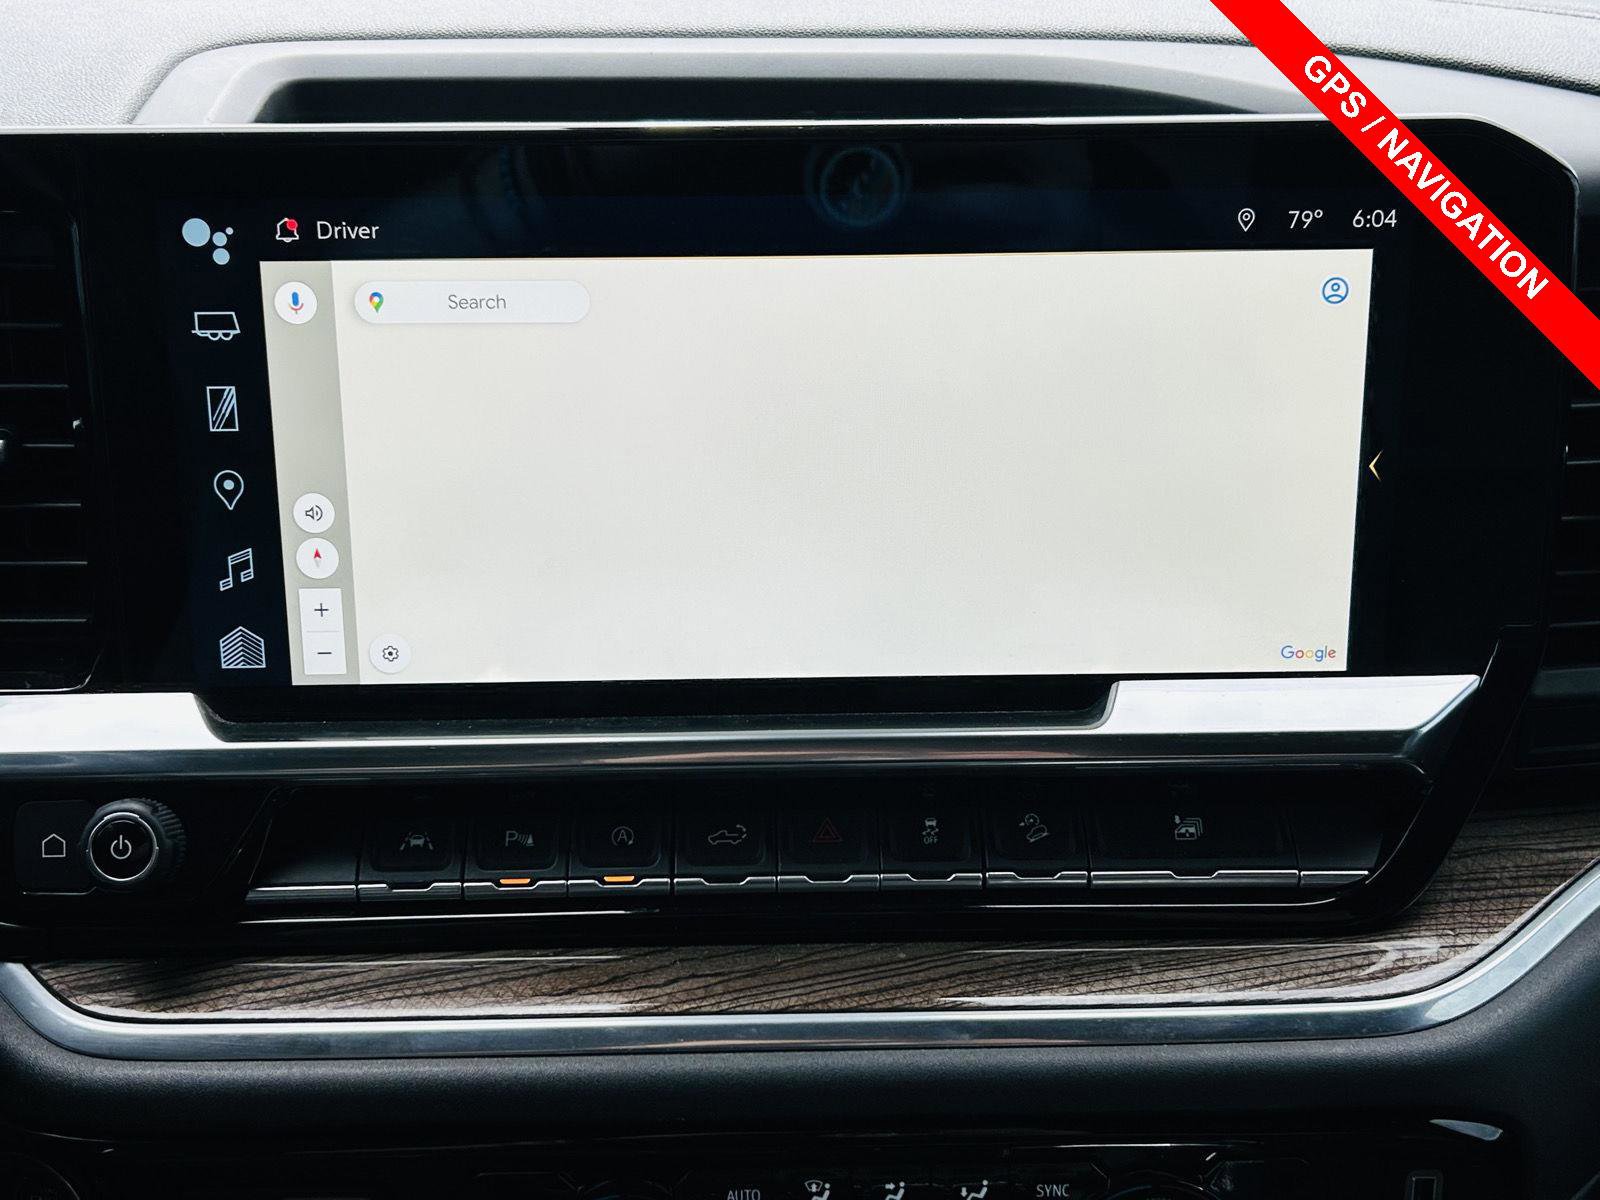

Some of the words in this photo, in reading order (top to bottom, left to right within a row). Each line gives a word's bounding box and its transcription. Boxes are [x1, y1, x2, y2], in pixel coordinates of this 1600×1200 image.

[1288, 209, 1324, 229] 79°
[1352, 209, 1398, 228] 6:04
[315, 220, 380, 241] Driver
[447, 294, 507, 311] Search
[1280, 643, 1337, 663] Google
[726, 1189, 762, 1200] AUTO
[1036, 1183, 1071, 1198] SYNC
